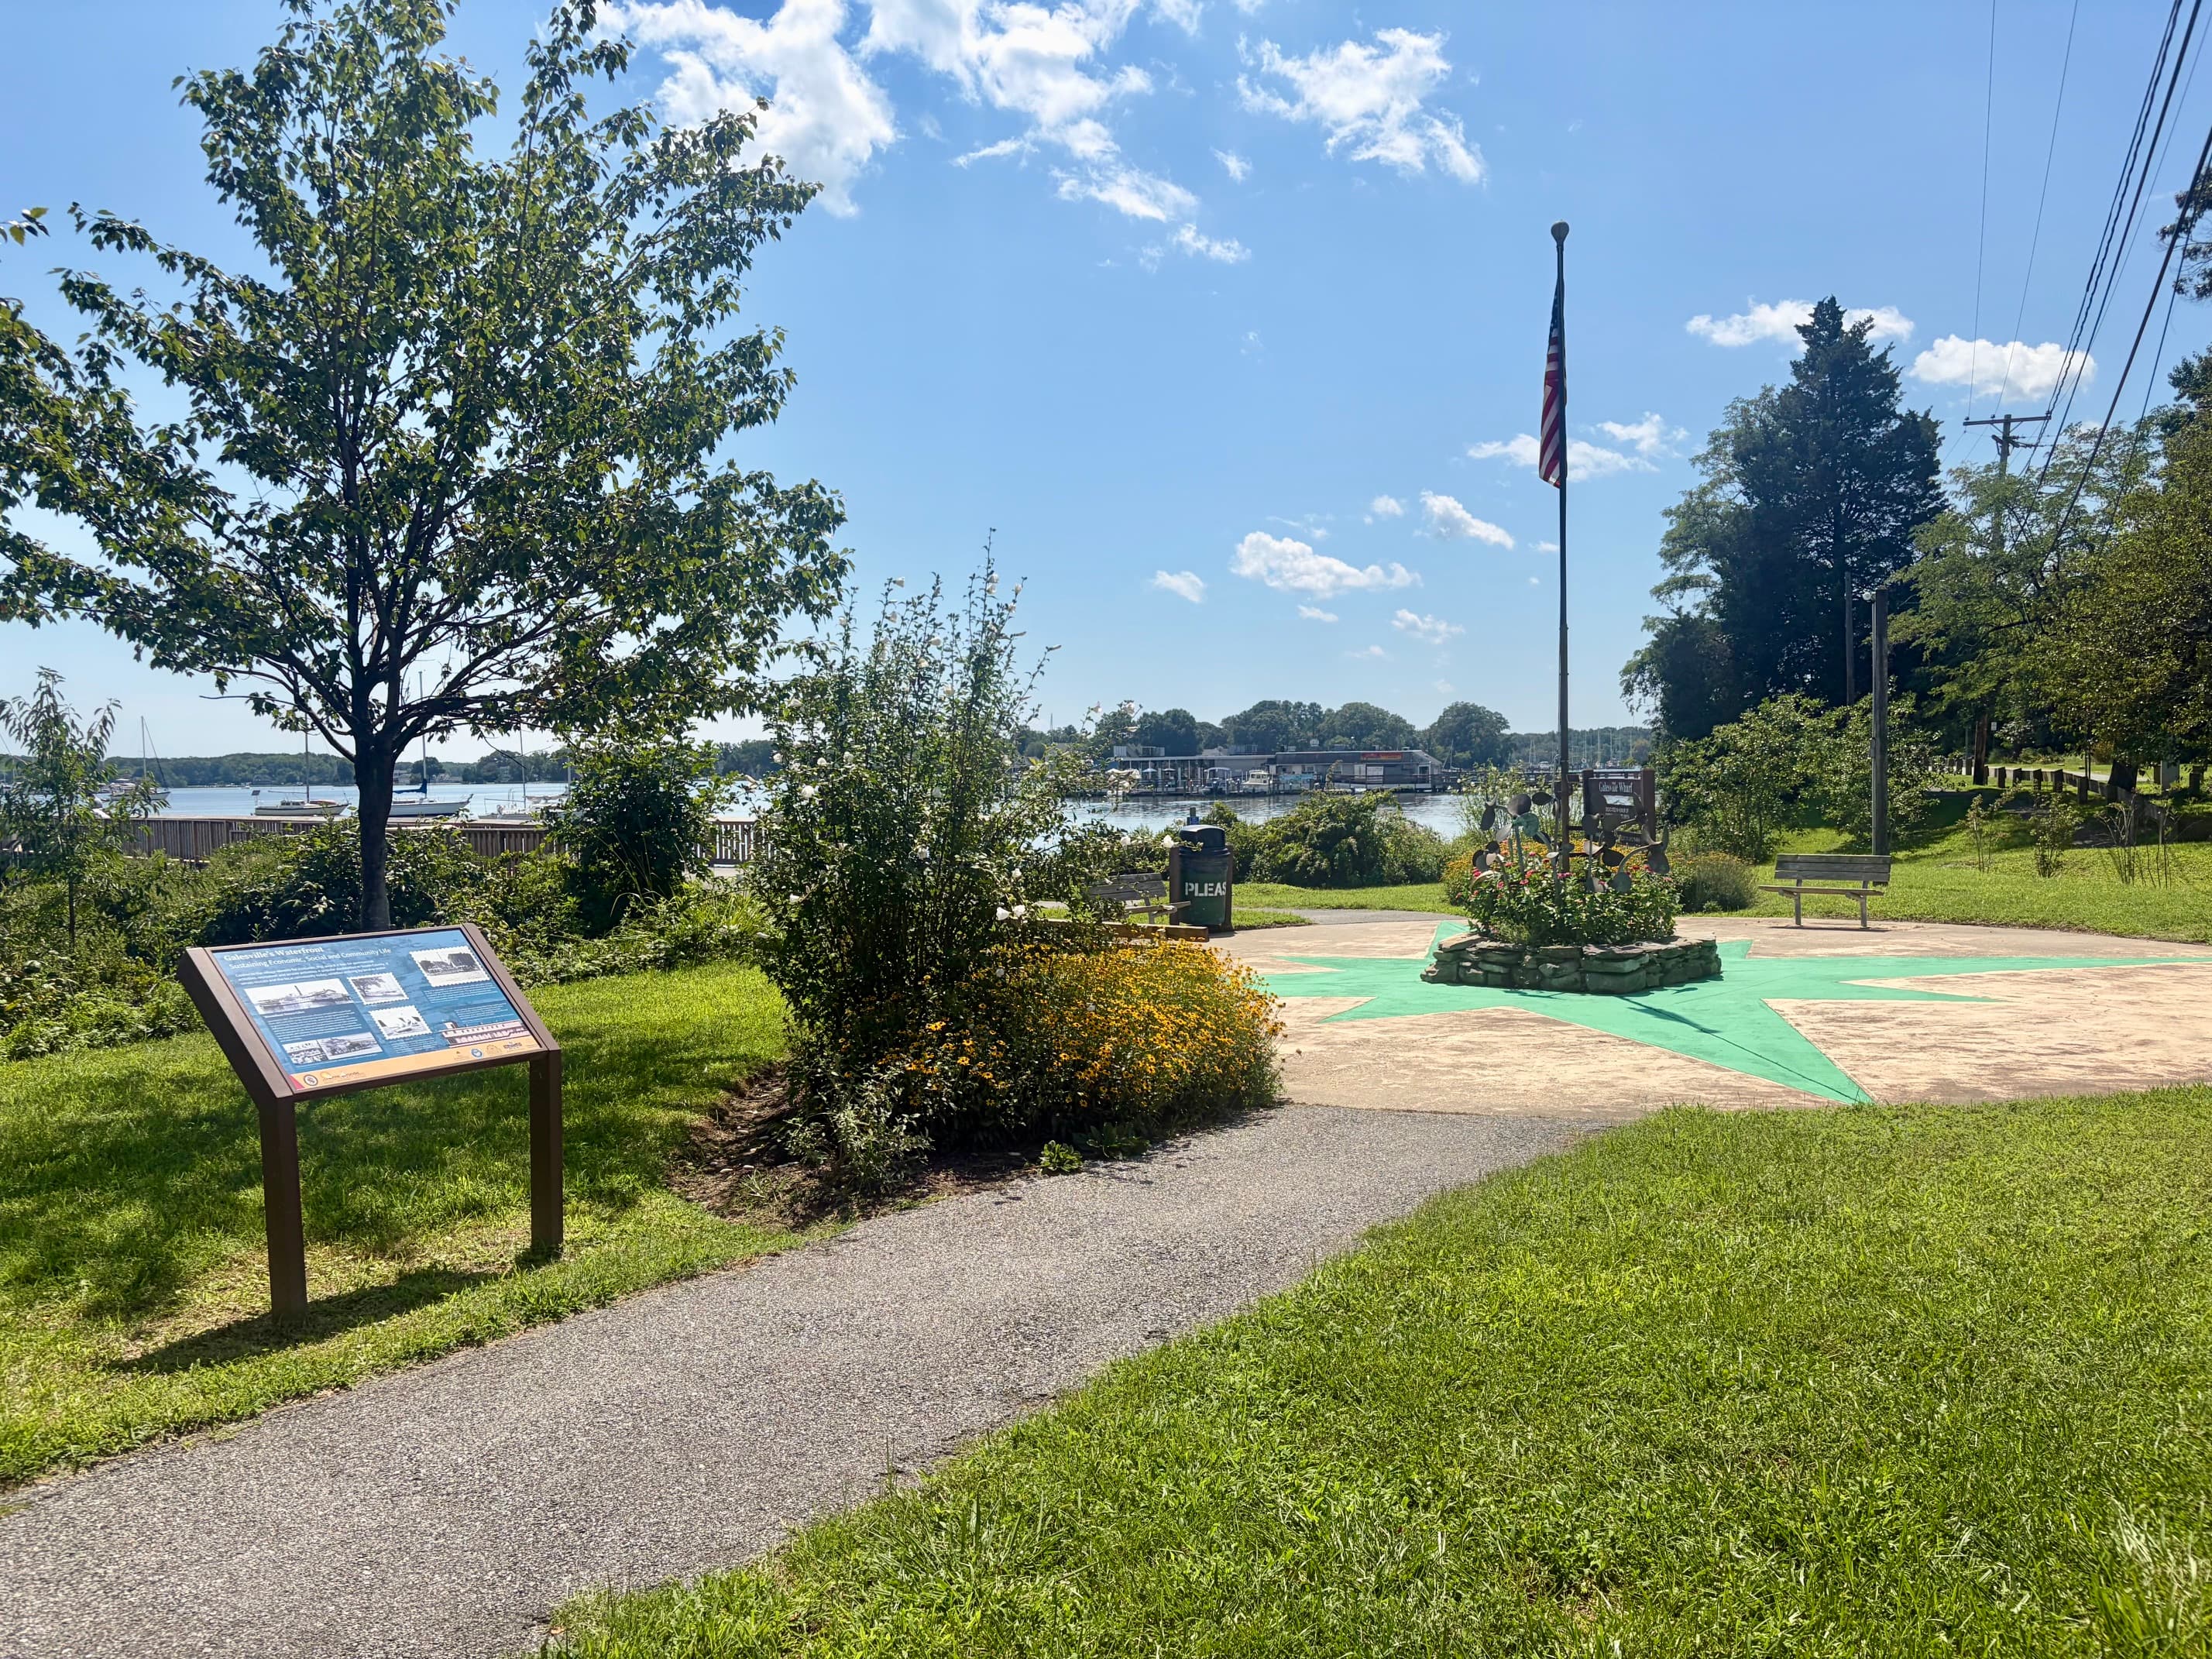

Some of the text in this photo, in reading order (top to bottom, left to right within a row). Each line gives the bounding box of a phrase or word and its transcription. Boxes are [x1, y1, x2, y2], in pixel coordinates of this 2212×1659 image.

[1619, 781, 1633, 793] Wharf
[223, 946, 324, 961] Galesville's Waterfront
[228, 960, 270, 970] Sustaining
[269, 957, 306, 966] Economic,
[306, 953, 327, 962] Social
[341, 950, 379, 958] Community
